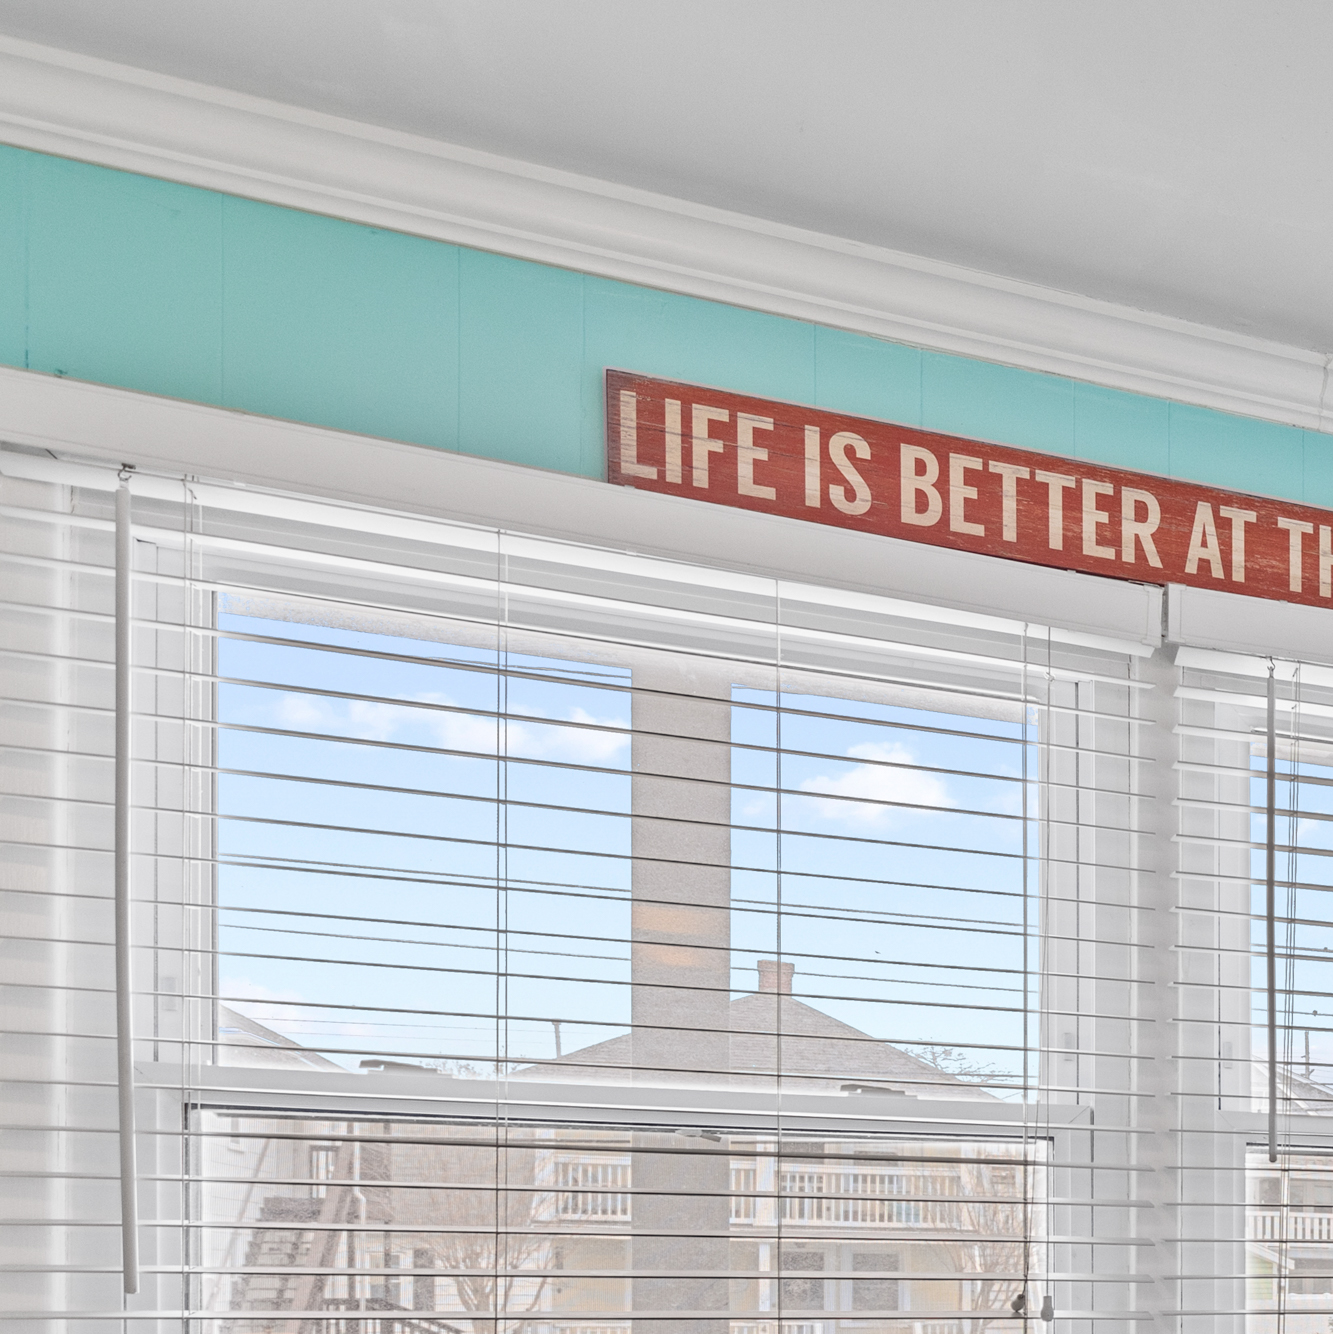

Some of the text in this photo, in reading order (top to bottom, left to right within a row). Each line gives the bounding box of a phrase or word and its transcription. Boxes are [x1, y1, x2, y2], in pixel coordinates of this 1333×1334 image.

[619, 390, 776, 500] LIFE
[804, 424, 872, 516] IS
[900, 443, 1163, 569] BETTER
[1185, 501, 1257, 583] AT
